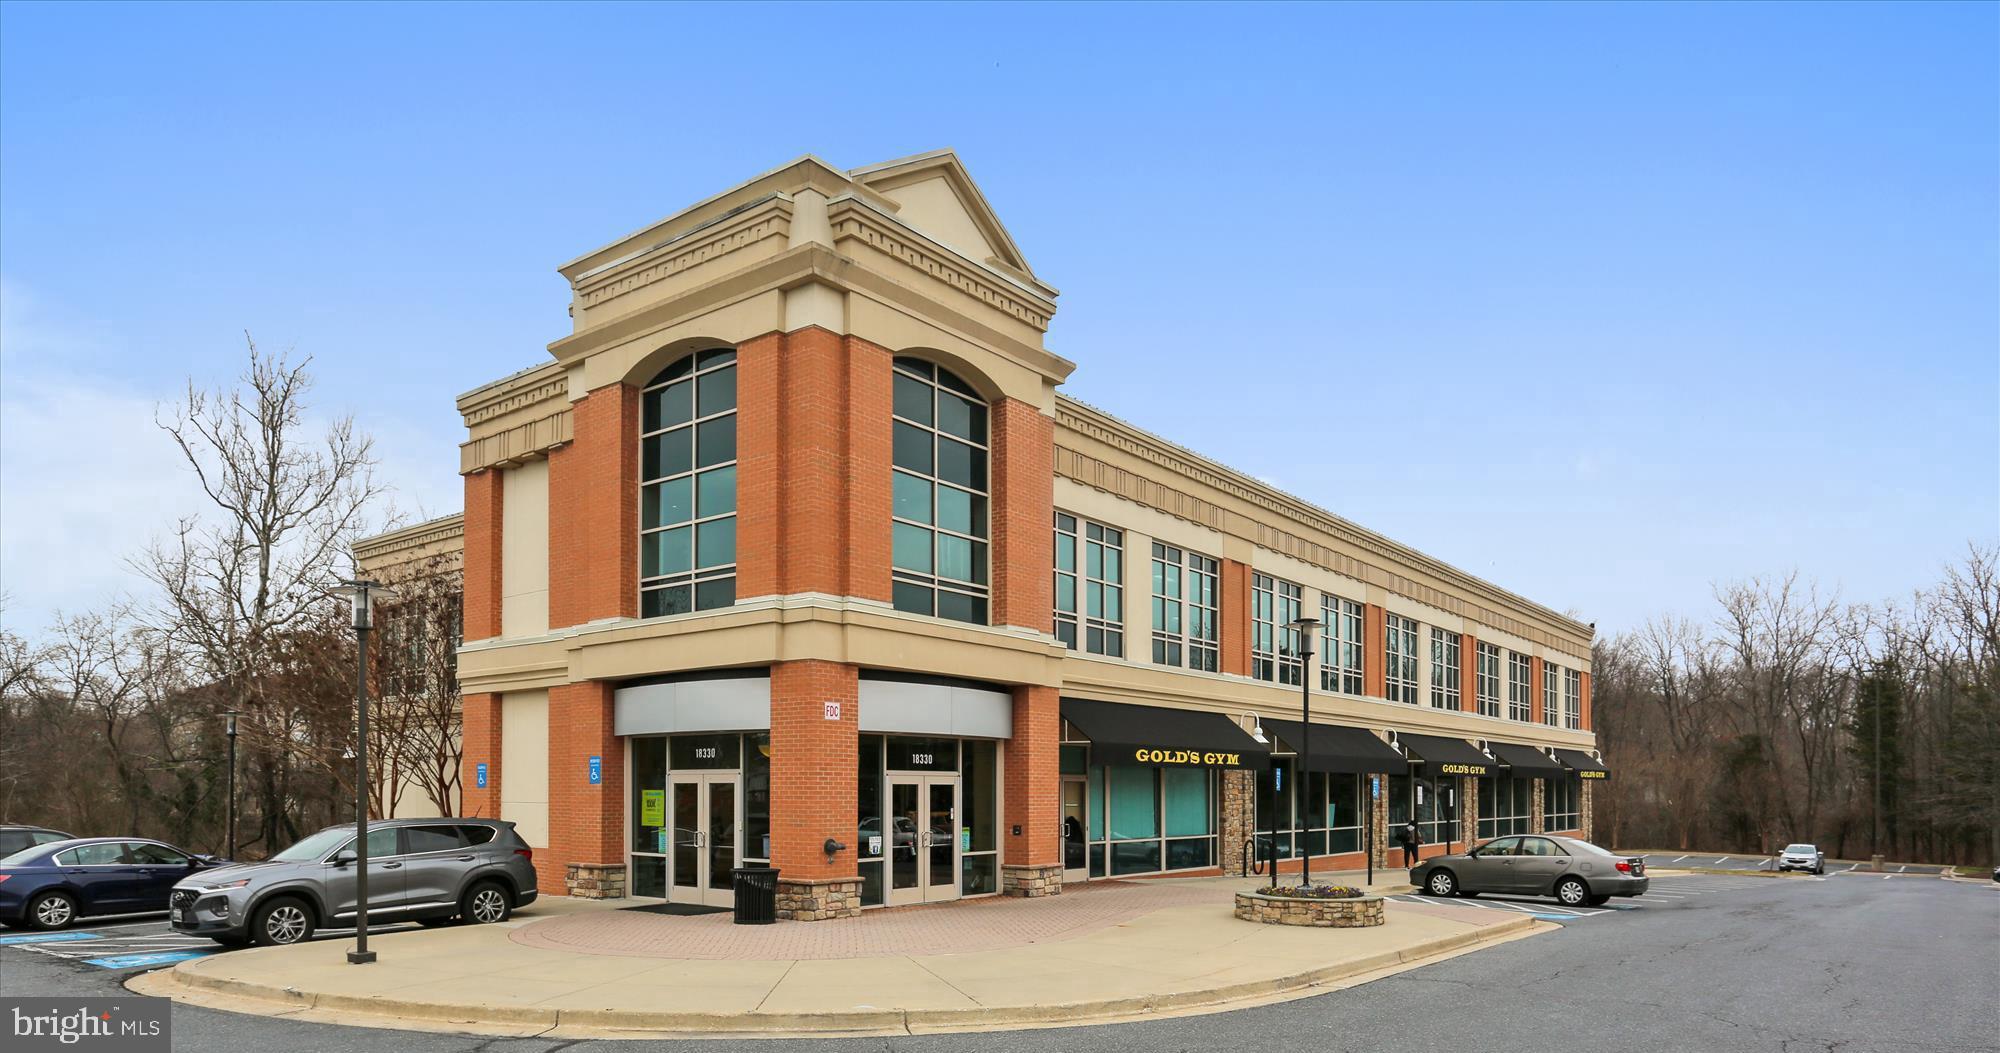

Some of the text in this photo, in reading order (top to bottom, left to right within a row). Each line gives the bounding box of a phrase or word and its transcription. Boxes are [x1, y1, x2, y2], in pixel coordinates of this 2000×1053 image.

[825, 705, 839, 717] FDC
[695, 747, 716, 759] 18330
[912, 753, 933, 765] 18330
[1135, 748, 1240, 766] GOLD'S GYM
[1442, 763, 1486, 775] GOLD'S GYM
